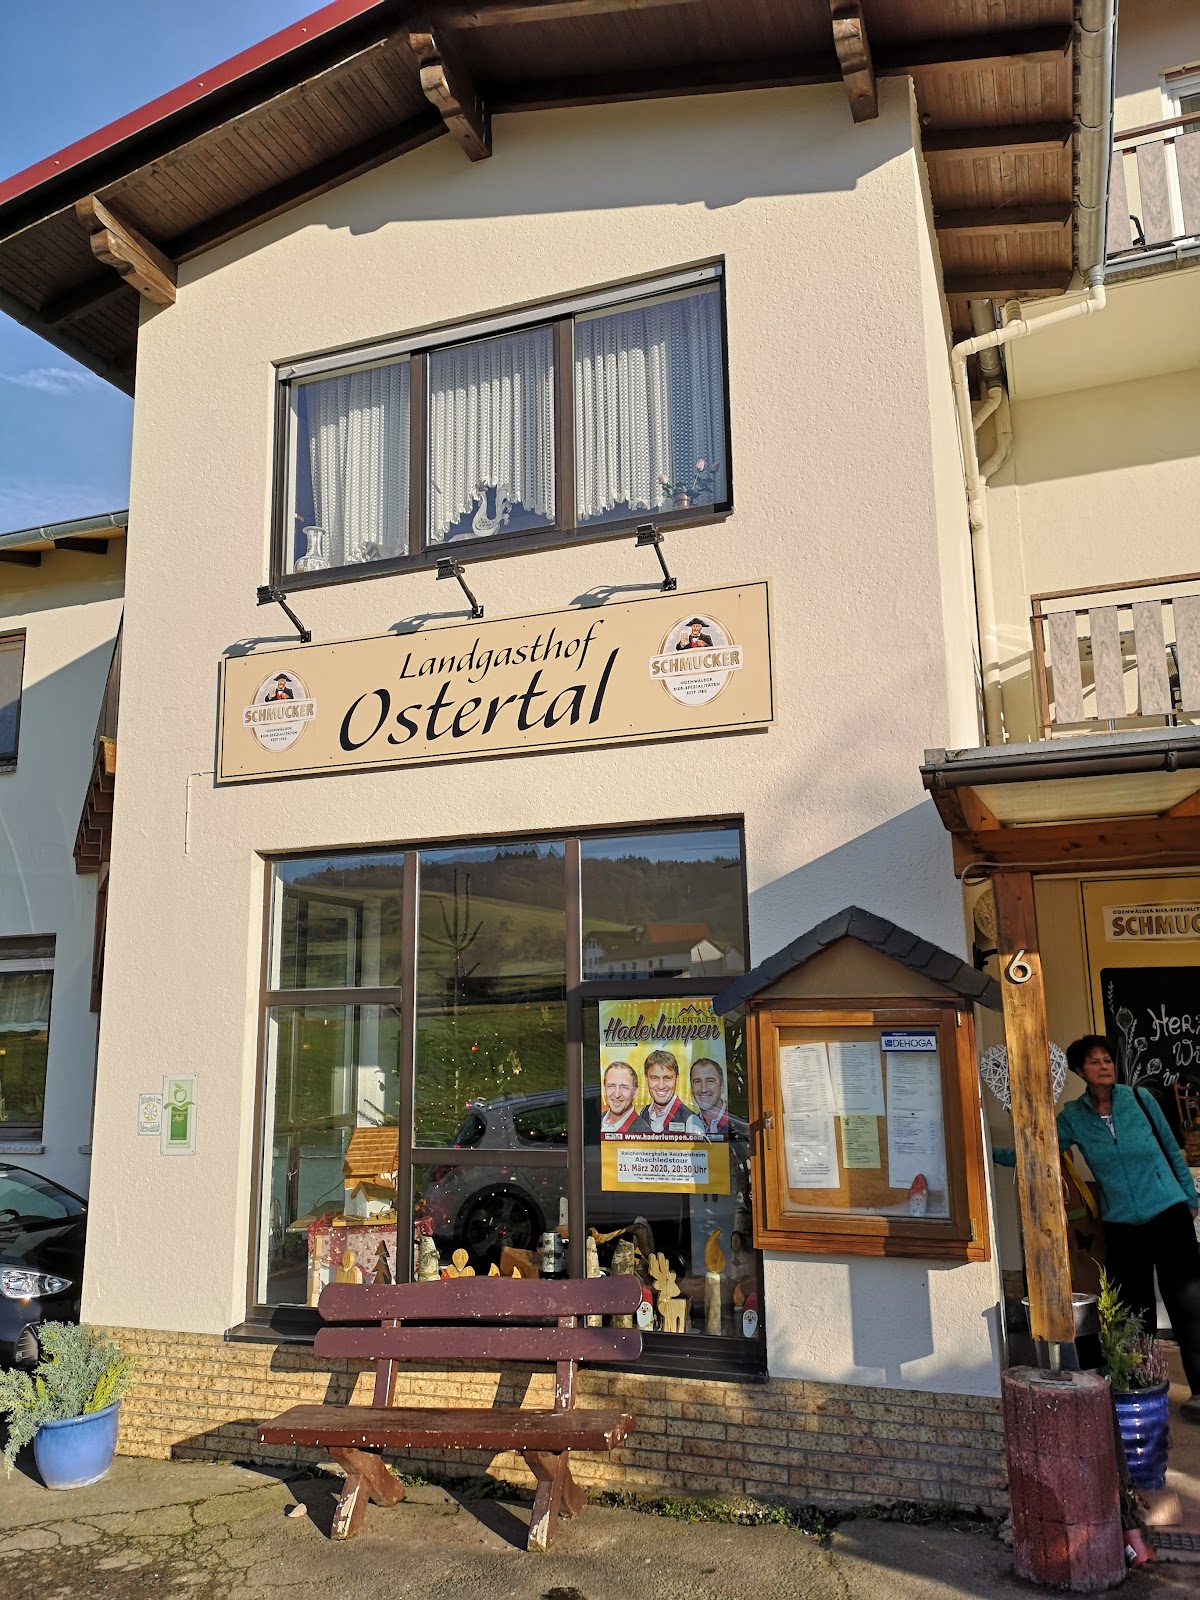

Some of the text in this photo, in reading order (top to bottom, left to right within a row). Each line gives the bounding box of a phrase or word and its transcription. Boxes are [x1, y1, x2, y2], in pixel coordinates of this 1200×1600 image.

[400, 619, 605, 684] Landgasthof
[651, 650, 741, 676] SCHMUCKER
[339, 647, 621, 752] Ostertal
[244, 703, 315, 724] SCHMUCKER
[1008, 949, 1033, 984] 6
[604, 1013, 721, 1048] Haderlumpen
[667, 1016, 717, 1025] ZILLERTALER
[892, 1039, 933, 1048] DEHOGA
[621, 1150, 668, 1158] Reichenberghalle
[634, 1156, 689, 1164] Abschiedstour
[618, 1163, 707, 1174] 21. März 2020, 20:30 Uhr
